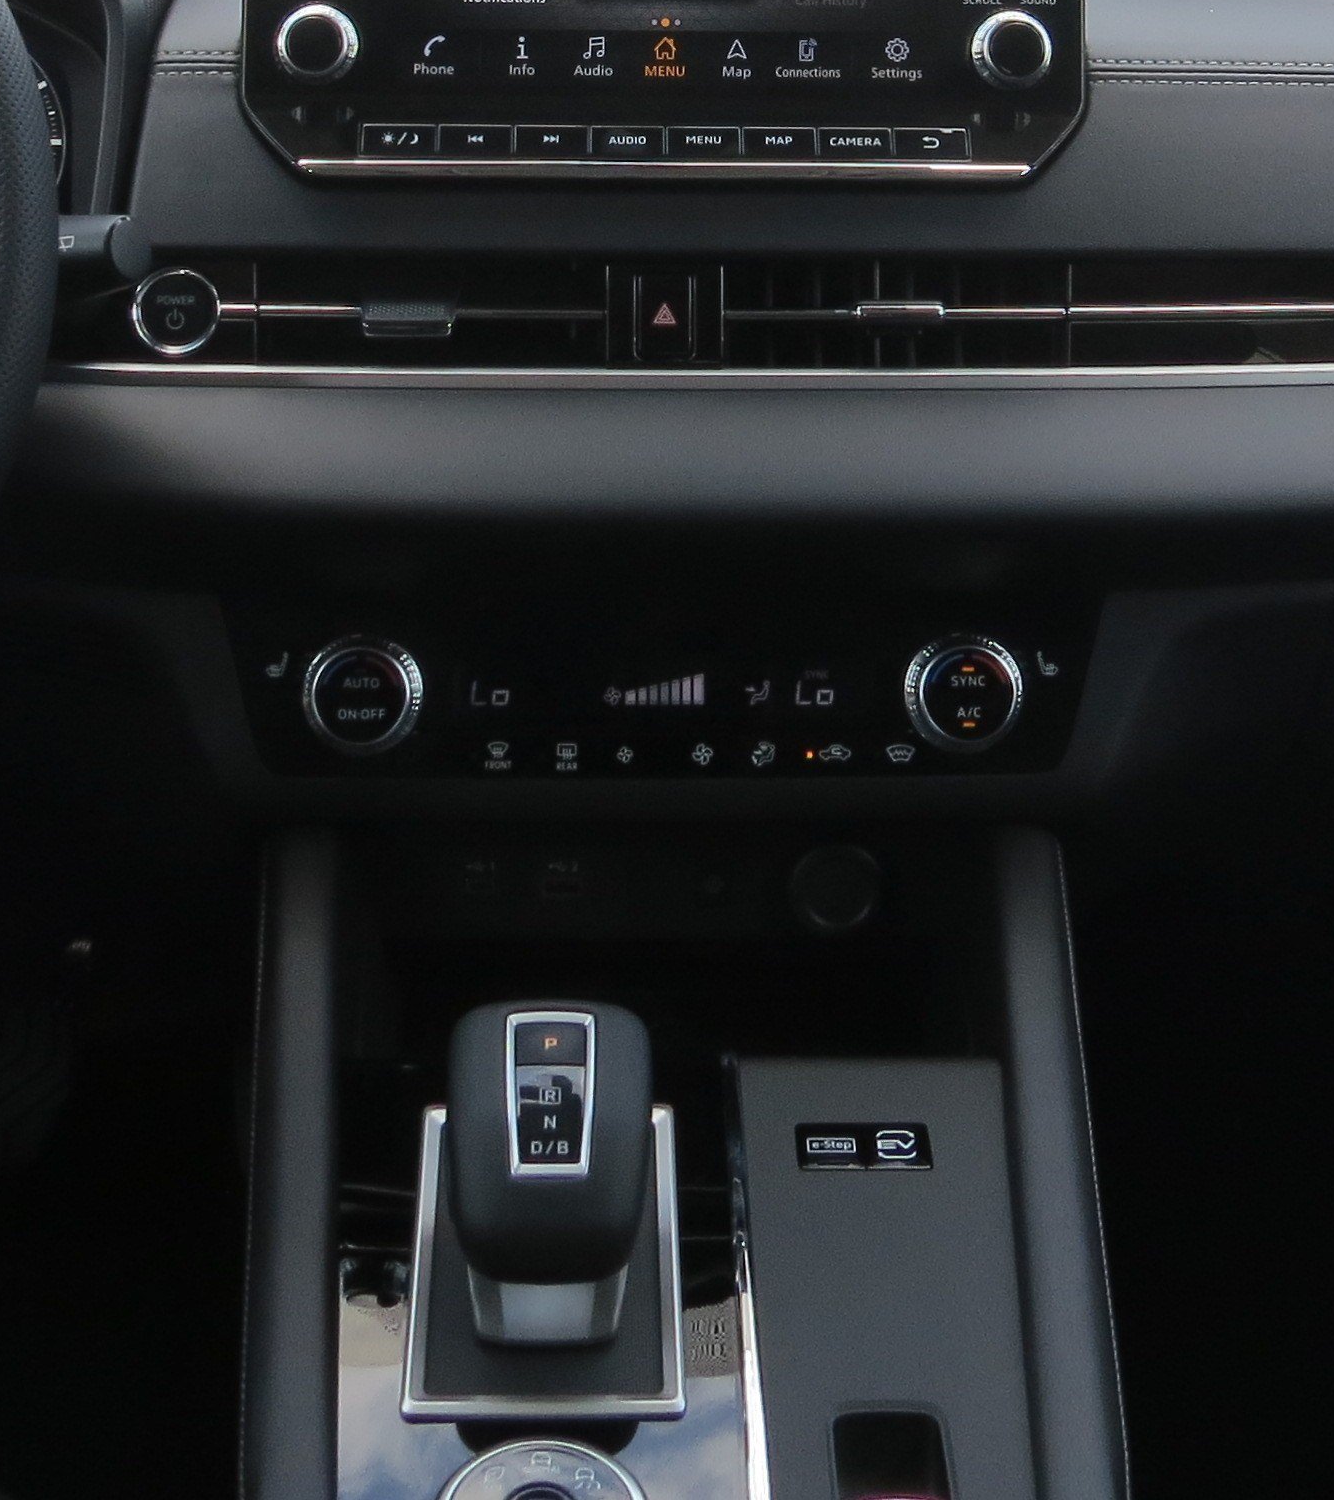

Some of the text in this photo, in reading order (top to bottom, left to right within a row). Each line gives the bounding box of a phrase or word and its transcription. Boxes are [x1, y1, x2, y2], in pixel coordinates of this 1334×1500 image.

[413, 62, 455, 76] Phone
[508, 62, 535, 76] Info
[573, 63, 613, 77] Audio
[644, 65, 685, 78] MENU
[722, 65, 752, 81] Map
[775, 65, 841, 79] Connections
[870, 66, 922, 82] Settings
[608, 134, 648, 146] AUDIO
[685, 134, 723, 145] MENU
[764, 134, 794, 145] MAP
[828, 135, 883, 147] CAMERA
[156, 294, 196, 306] POWER
[342, 676, 381, 690] AUTO
[951, 675, 986, 688] SYNC
[471, 680, 509, 706] Lo
[795, 679, 834, 705] Lo
[957, 705, 981, 719] A/C
[485, 760, 513, 771] FRONT
[556, 760, 579, 771] REAR
[544, 1037, 559, 1050] P
[543, 1115, 557, 1130] N
[811, 1140, 853, 1151] e-Step
